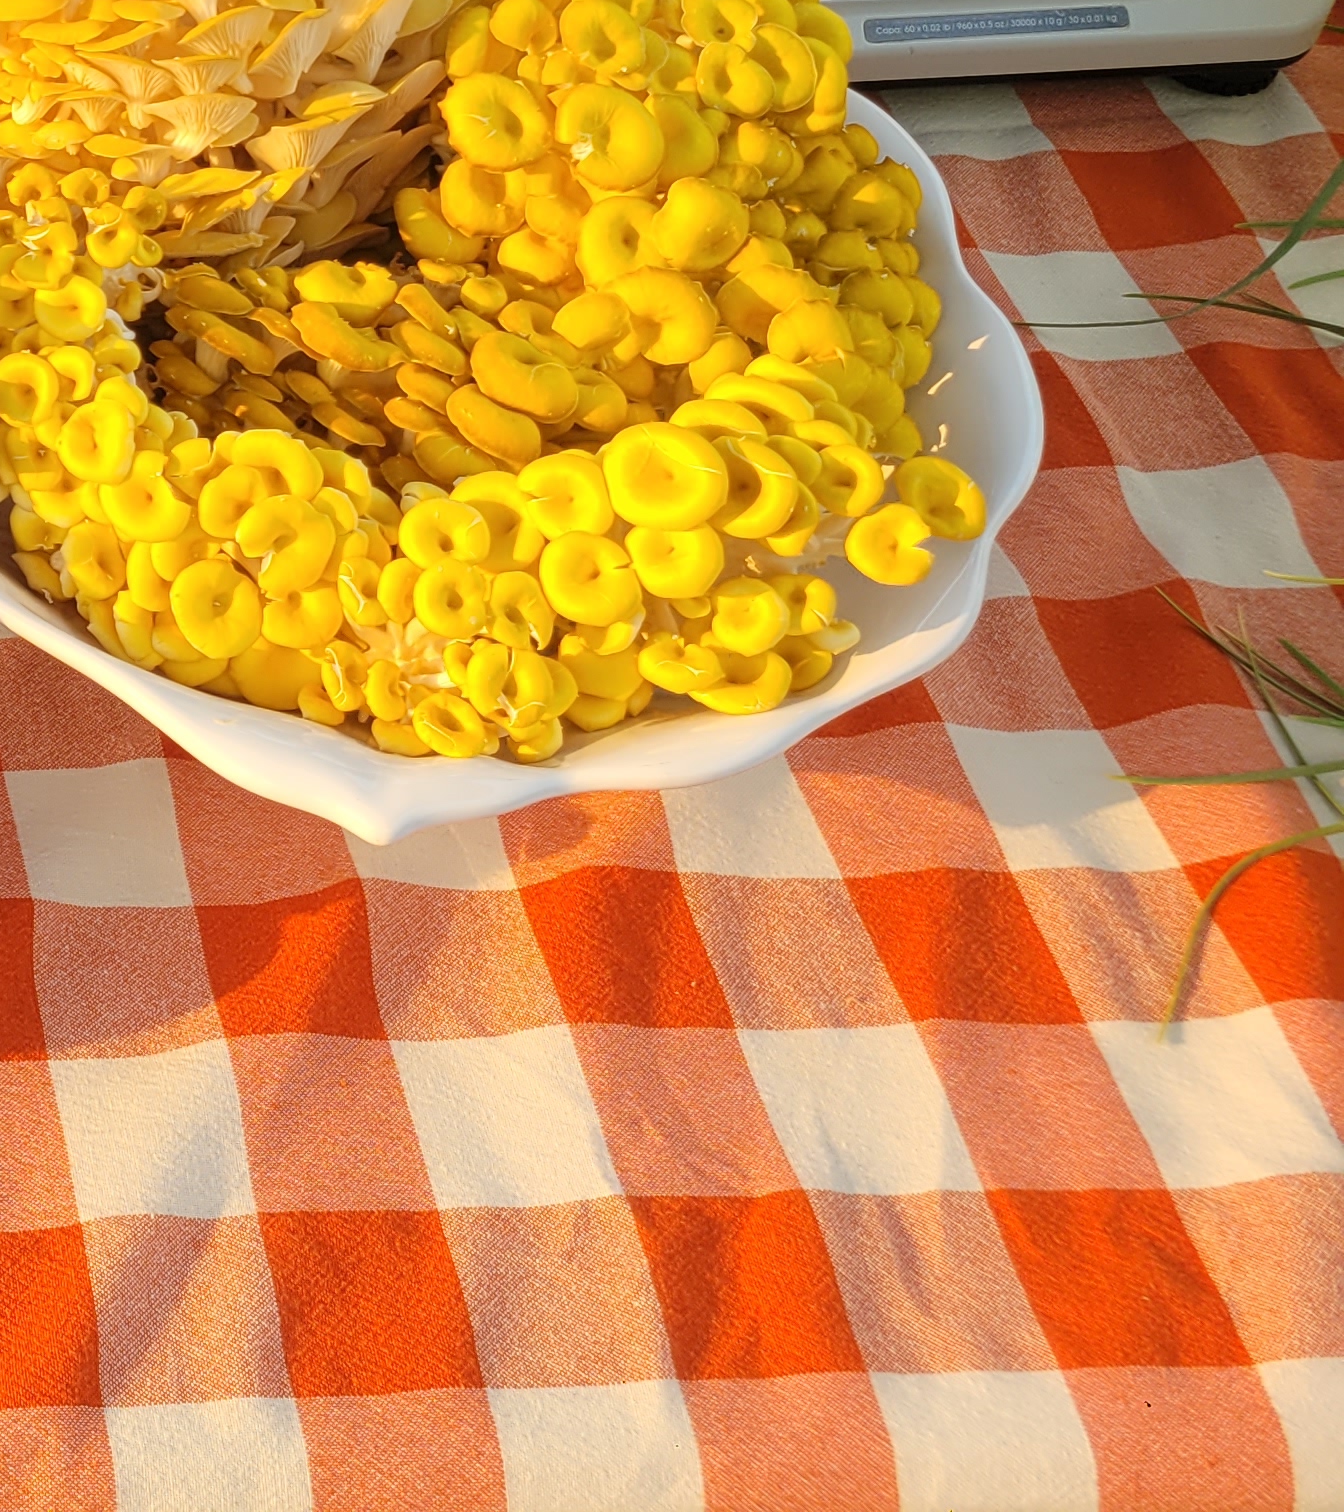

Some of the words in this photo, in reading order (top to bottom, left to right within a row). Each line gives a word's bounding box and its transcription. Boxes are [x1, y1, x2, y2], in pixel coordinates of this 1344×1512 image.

[875, 26, 902, 35] Capa:
[904, 24, 915, 33] 60
[922, 23, 941, 32] 0.02
[956, 21, 972, 30] 960
[979, 20, 993, 28] 0.5
[1011, 18, 1036, 27] 30000
[1045, 17, 1055, 25] 10
[1068, 15, 1079, 24] 30
[1087, 15, 1104, 23] 0.01
